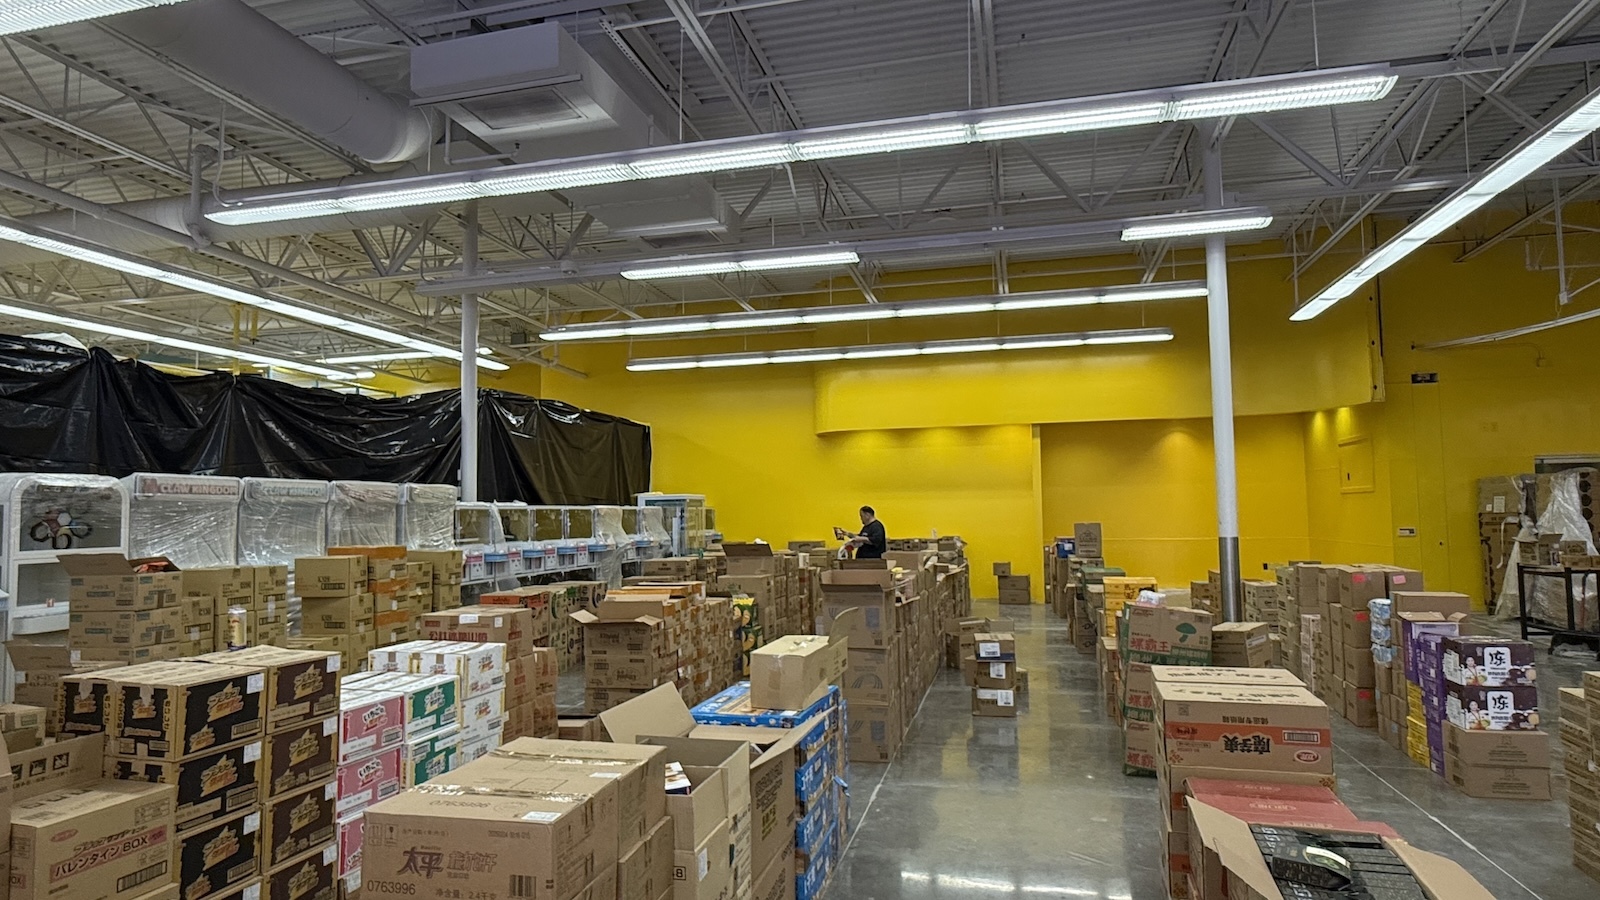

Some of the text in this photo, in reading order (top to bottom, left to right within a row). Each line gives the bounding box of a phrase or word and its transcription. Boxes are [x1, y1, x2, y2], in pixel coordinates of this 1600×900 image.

[160, 483, 239, 495] CLAW KINGDOM
[1221, 734, 1271, 755] 魔芋爽
[55, 846, 120, 877] バレンタイン
[122, 835, 148, 852] BOX
[397, 846, 444, 879] 太平
[367, 880, 416, 896] 0763996
